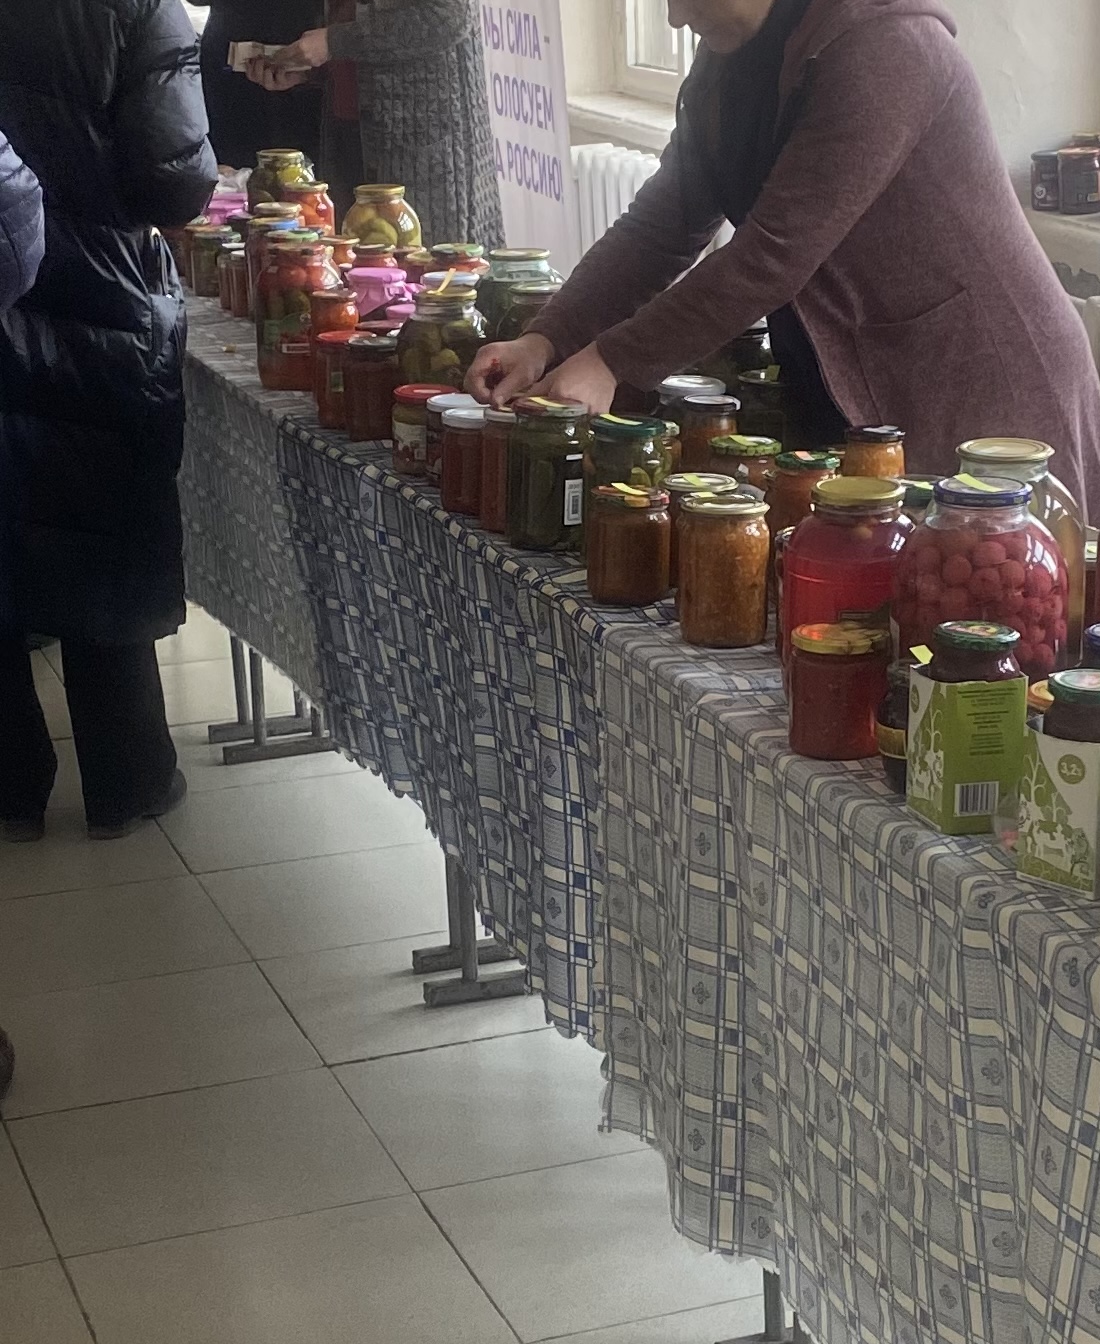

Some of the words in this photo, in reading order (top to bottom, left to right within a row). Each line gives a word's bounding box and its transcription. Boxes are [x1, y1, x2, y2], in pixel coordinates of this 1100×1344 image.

[482, 4, 505, 52] МЫ
[506, 8, 542, 61] СИЛА
[490, 70, 555, 134] ОЛОСУЕМ
[494, 137, 505, 181] А
